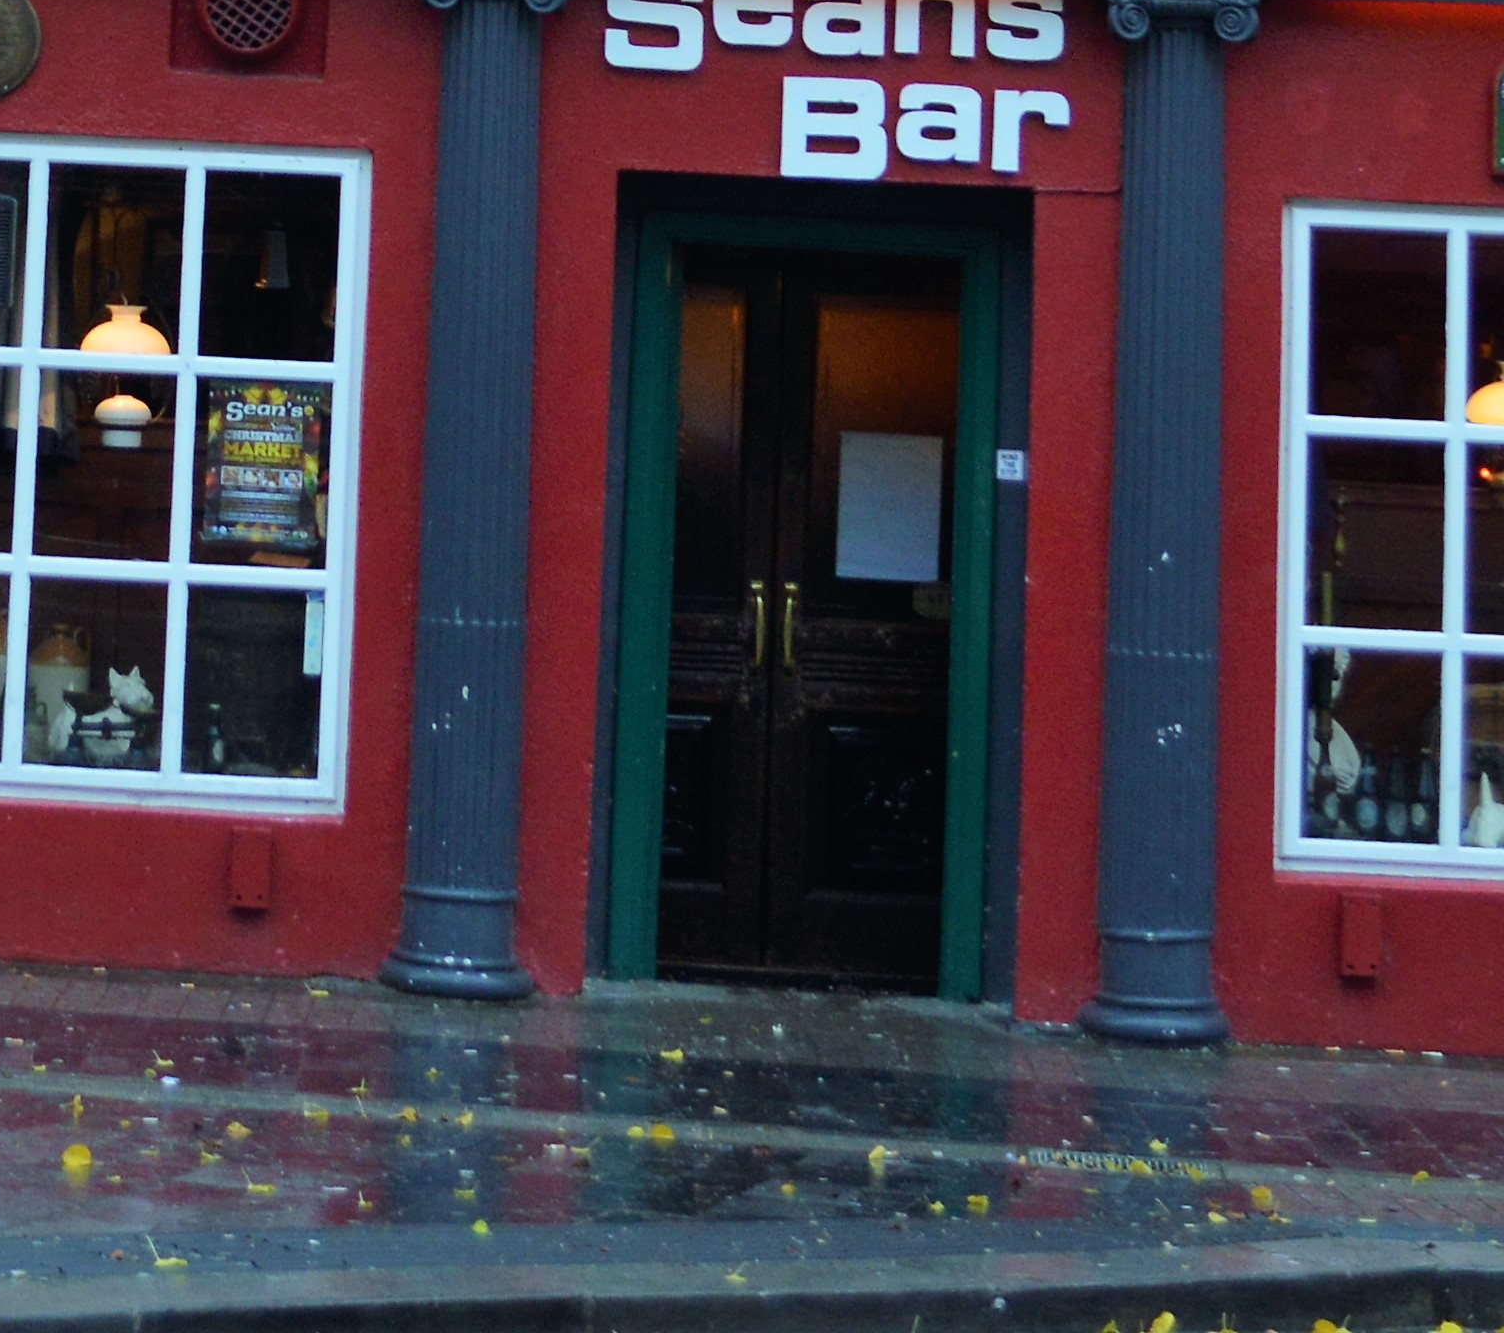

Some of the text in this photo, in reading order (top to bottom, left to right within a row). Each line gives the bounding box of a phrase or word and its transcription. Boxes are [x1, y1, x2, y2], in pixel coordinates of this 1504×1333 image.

[780, 76, 1070, 181] Bar
[225, 400, 305, 422] Sean's
[223, 440, 304, 460] MARKET
